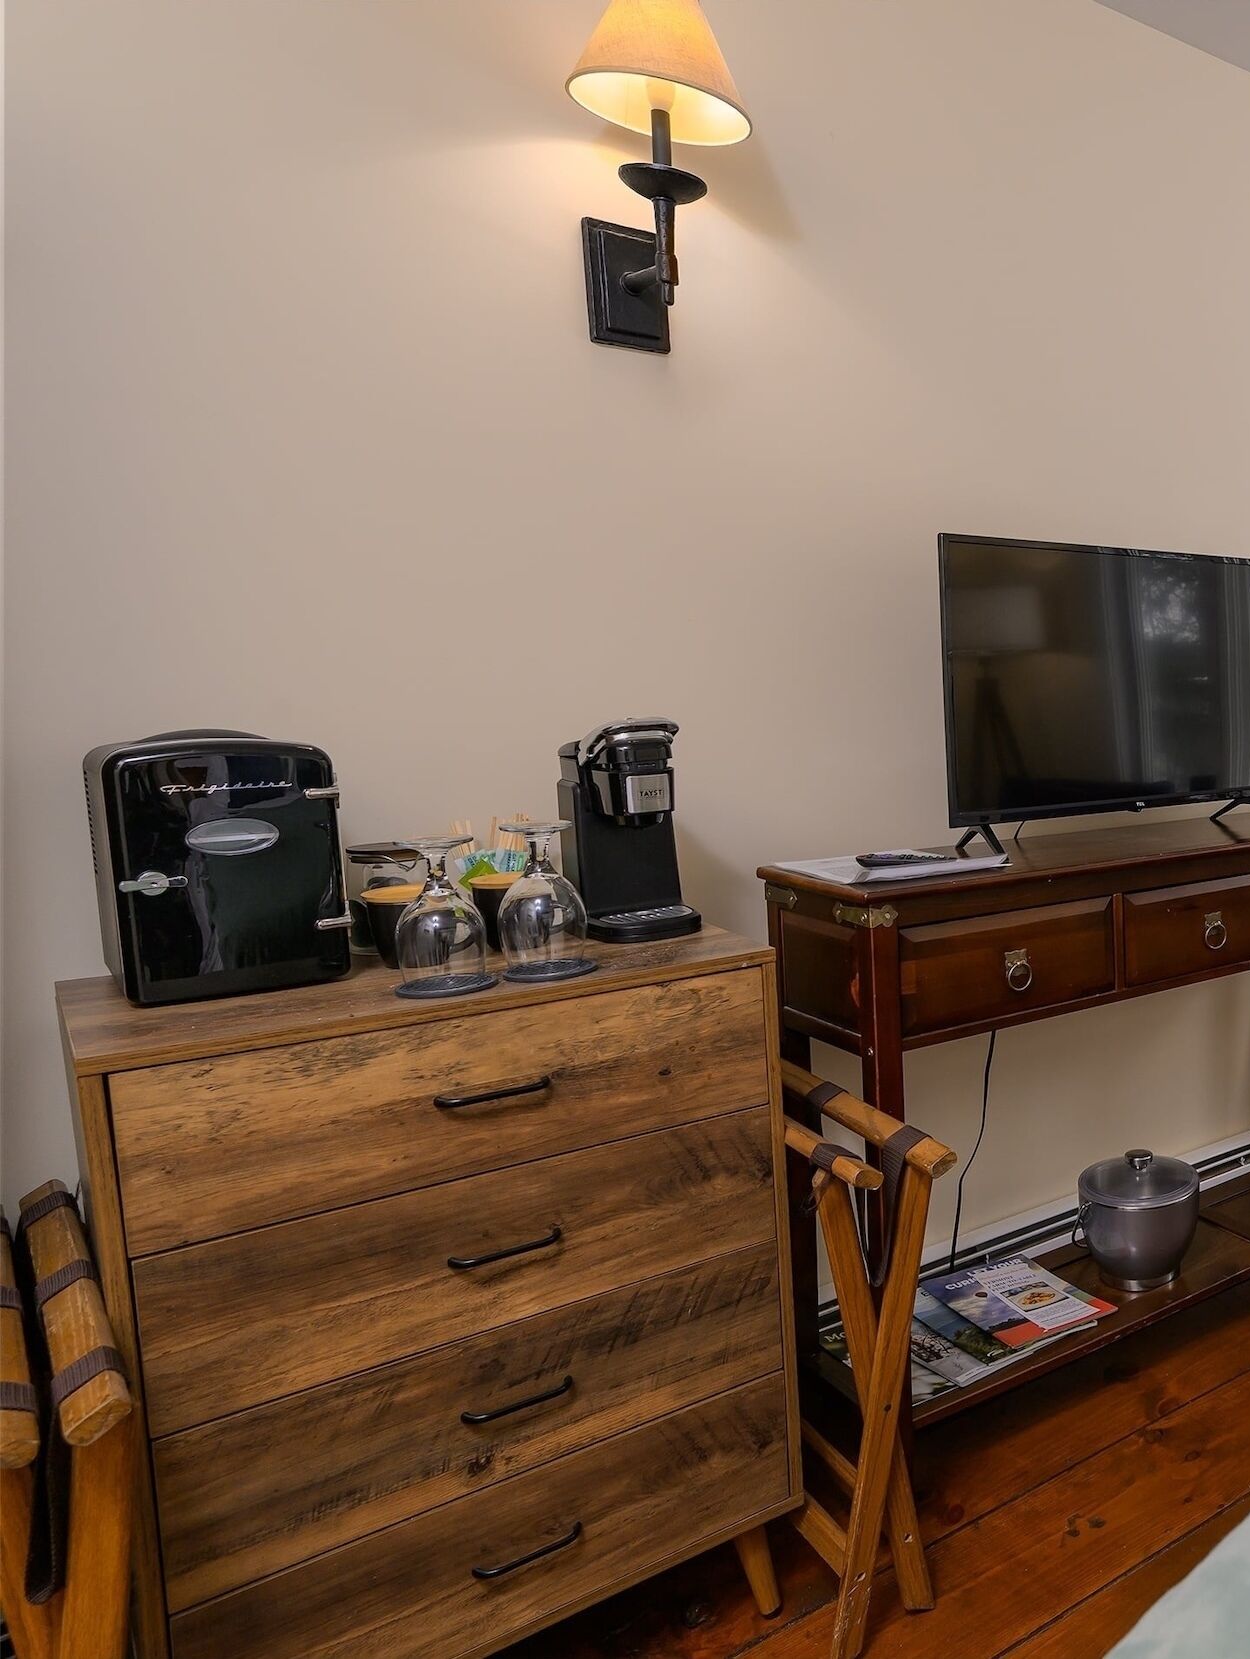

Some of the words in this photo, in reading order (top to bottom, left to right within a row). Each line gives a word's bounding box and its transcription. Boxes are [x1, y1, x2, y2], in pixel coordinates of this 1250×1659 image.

[159, 780, 293, 795] Frigidaire
[640, 789, 662, 797] TAYST
[989, 1258, 1023, 1271] YOUR
[945, 1277, 976, 1290] CURI
